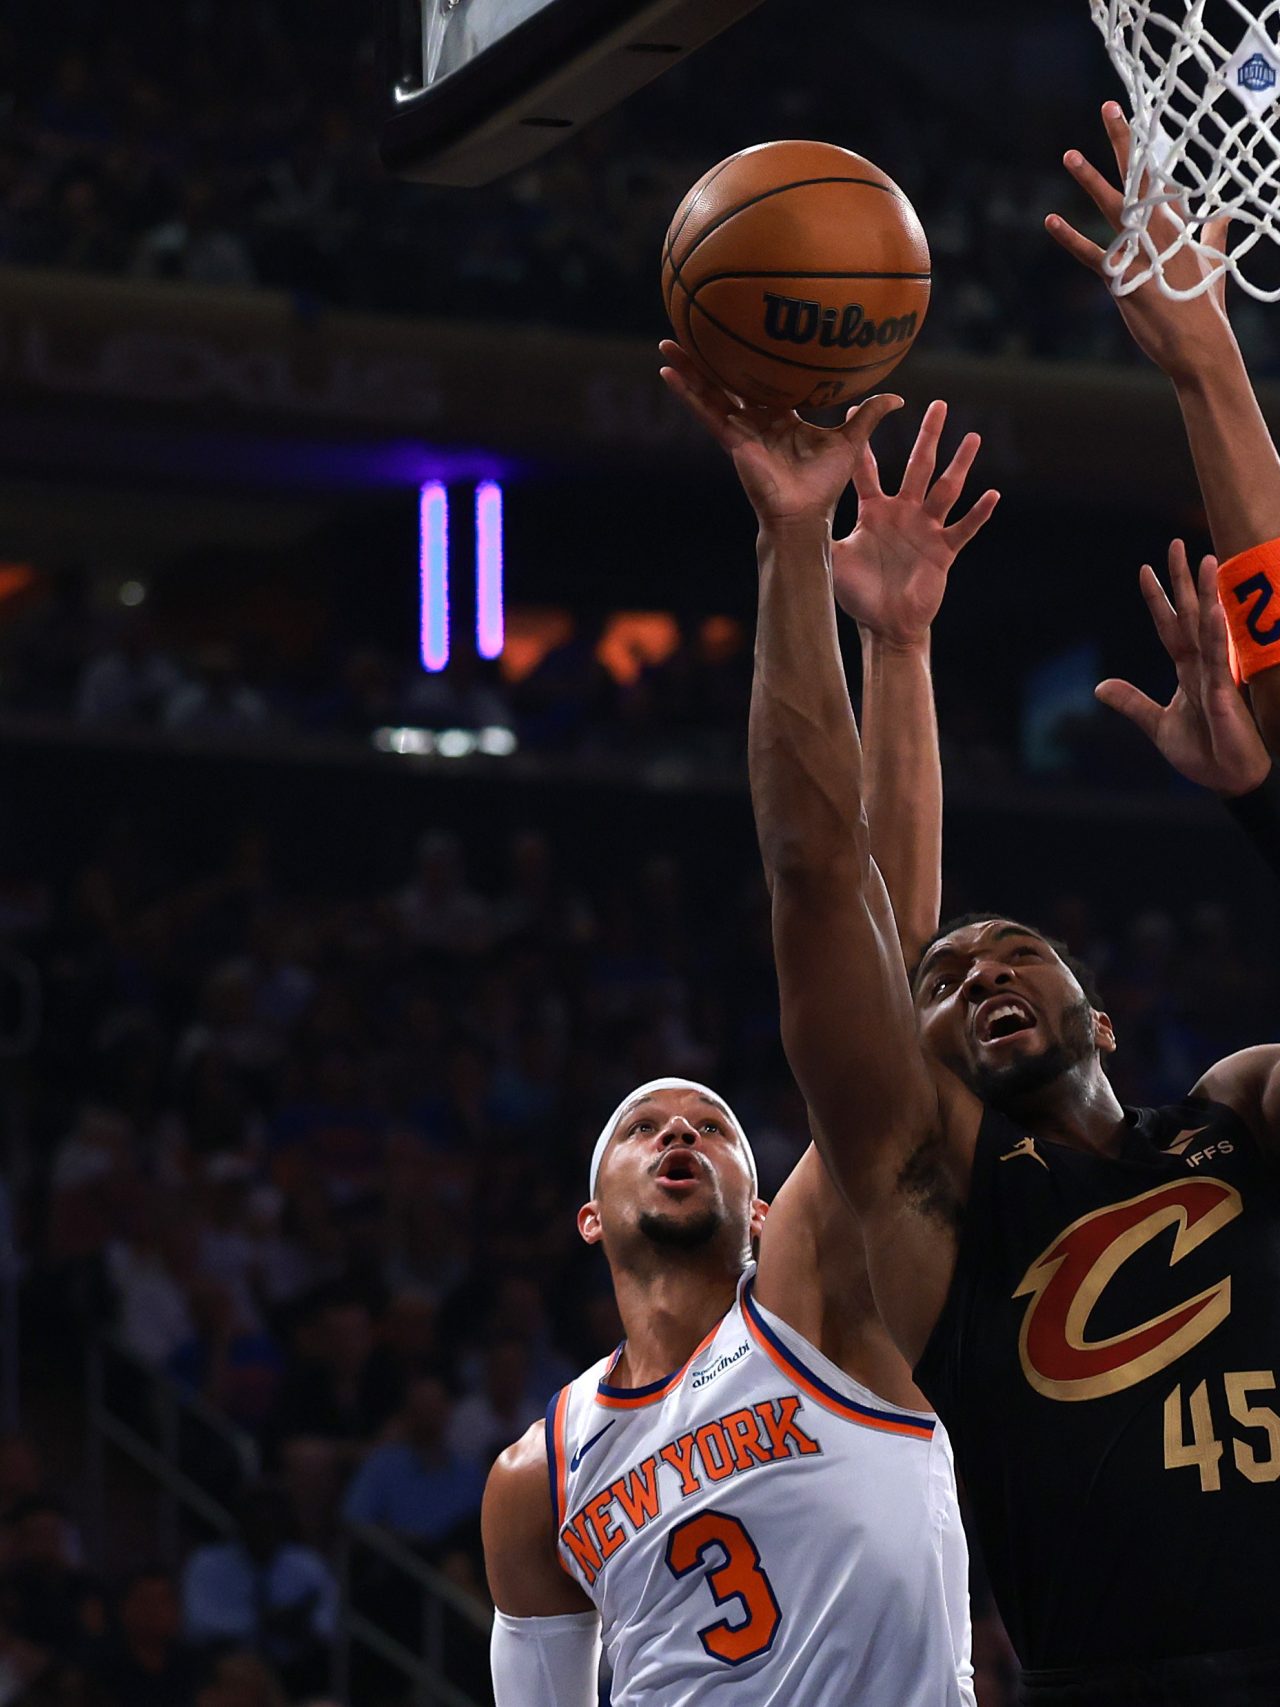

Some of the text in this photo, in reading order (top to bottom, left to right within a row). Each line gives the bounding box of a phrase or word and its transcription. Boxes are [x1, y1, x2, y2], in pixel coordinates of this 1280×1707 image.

[763, 292, 918, 348] Wilson
[1185, 1140, 1234, 1168] IFFS
[560, 1395, 824, 1588] NEW YORK
[664, 1507, 783, 1667] 3
